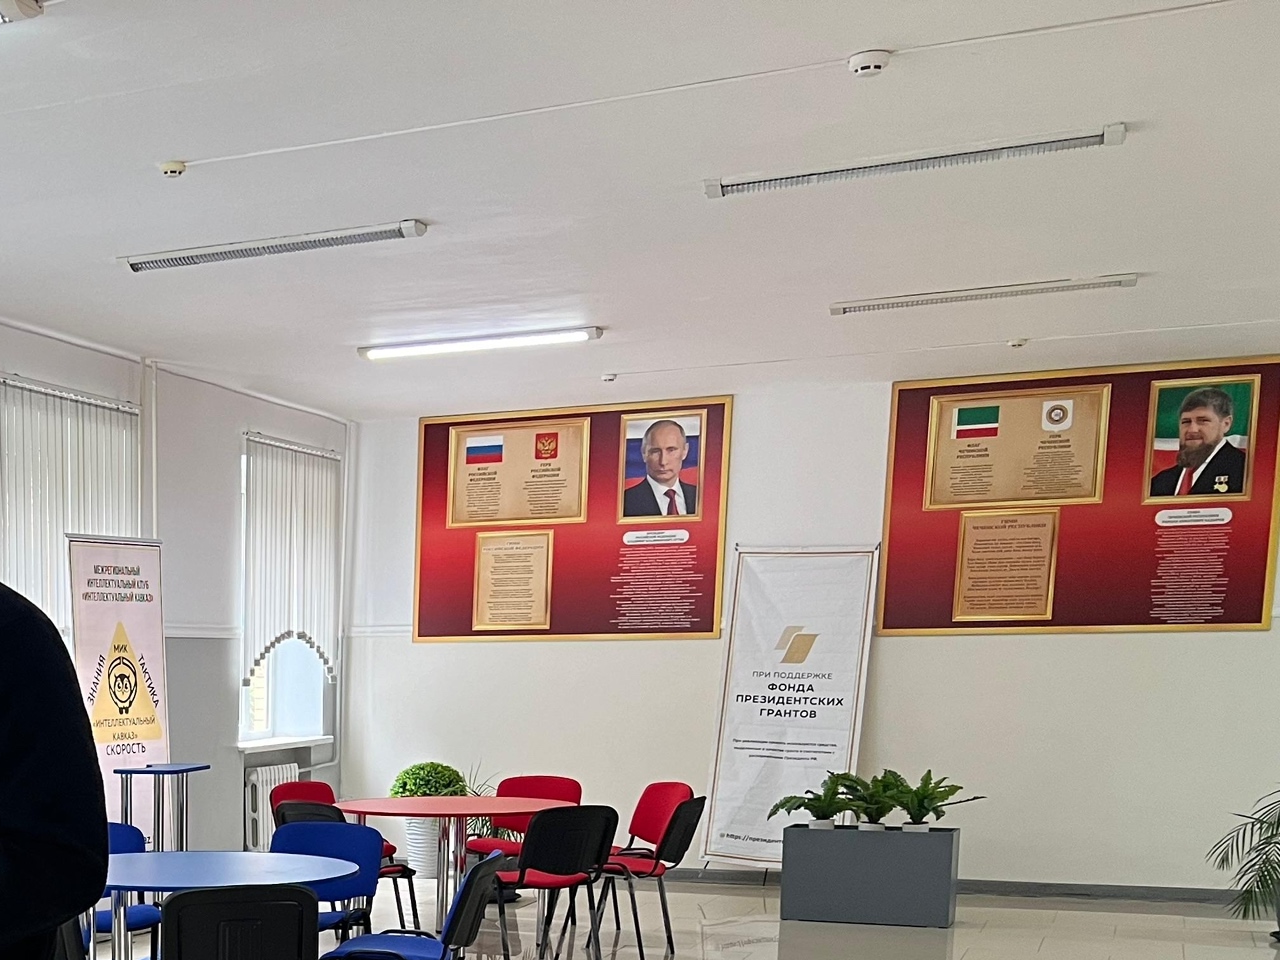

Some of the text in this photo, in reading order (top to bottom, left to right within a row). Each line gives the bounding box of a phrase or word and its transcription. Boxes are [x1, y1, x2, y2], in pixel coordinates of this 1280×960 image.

[113, 644, 128, 653] МИК
[87, 654, 106, 705] ЗНАНИЯ
[138, 653, 159, 708] ТАКТИКА
[752, 670, 833, 680] ПРИ ПОДДЕРЖКЕ
[767, 683, 814, 693] ФОНДА
[736, 694, 844, 706] ПРЕЗИДЕНТСКИХ
[759, 708, 817, 719] ГРАНТОВ
[93, 715, 156, 728] «ИНТЕЛЛЕКТУАЛЬНЫЙ
[112, 732, 138, 741] КАВКАЗ»
[106, 743, 146, 756] СКОРОСТЬ
